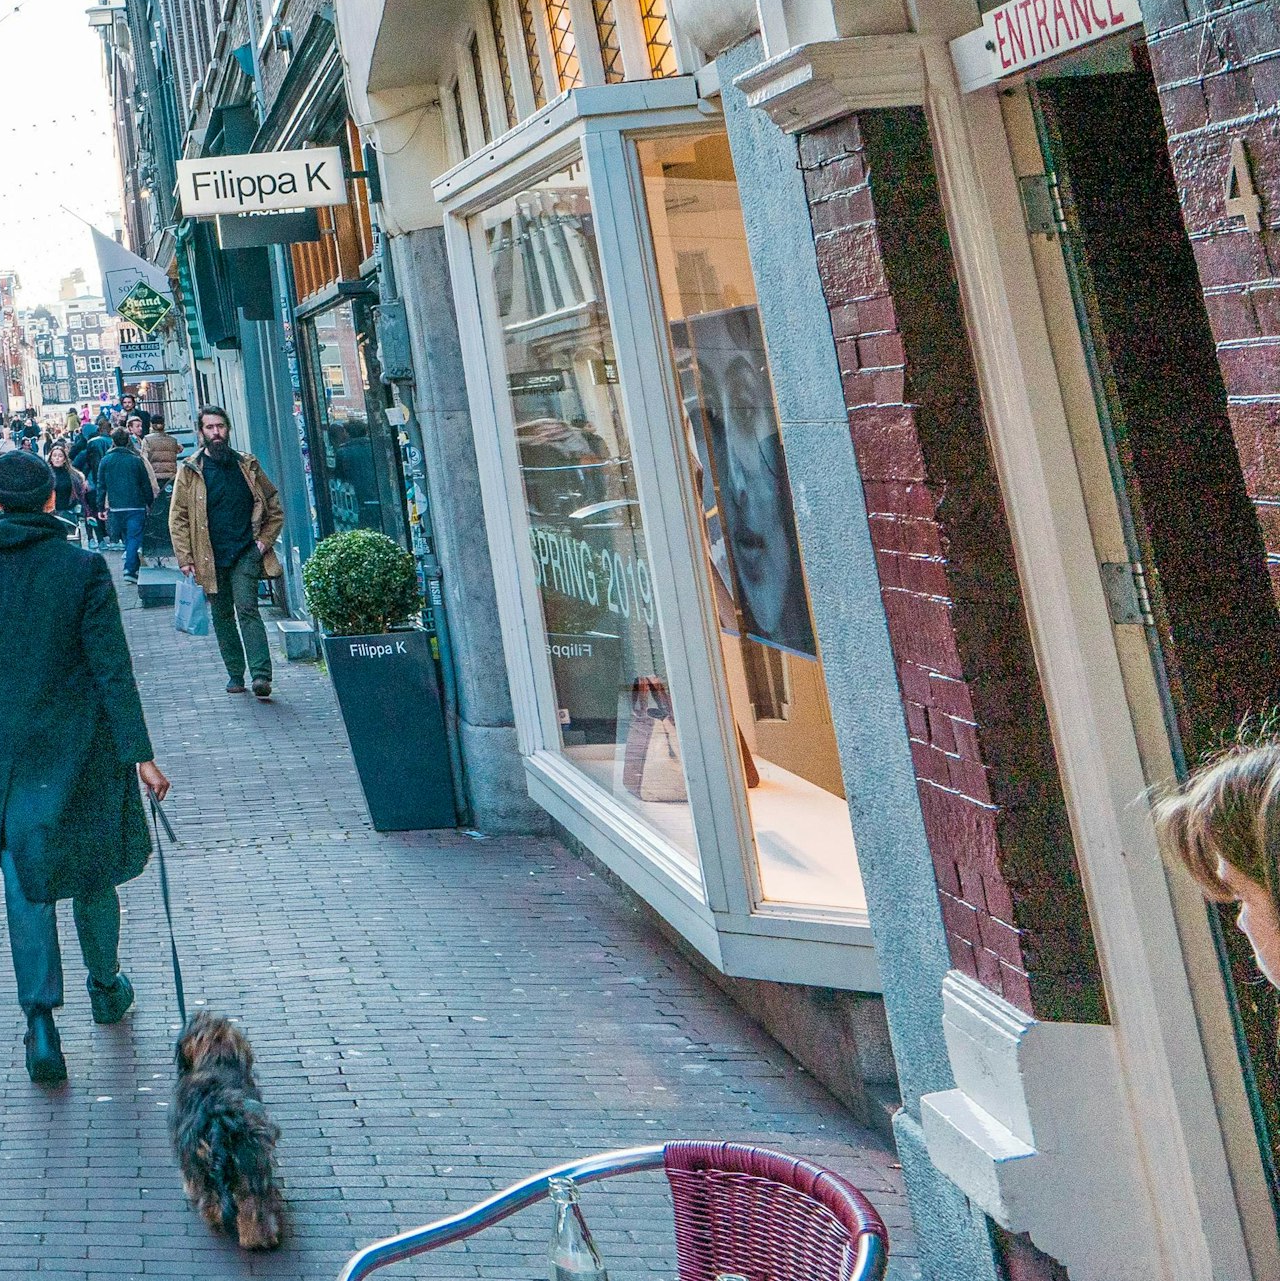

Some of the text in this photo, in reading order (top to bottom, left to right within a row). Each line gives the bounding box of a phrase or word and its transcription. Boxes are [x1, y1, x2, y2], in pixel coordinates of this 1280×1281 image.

[192, 161, 331, 205] Filippa K
[1226, 138, 1260, 232] 4
[125, 296, 161, 309] Brand
[529, 527, 654, 629] SPRING 2019
[350, 641, 407, 659] Filippa K
